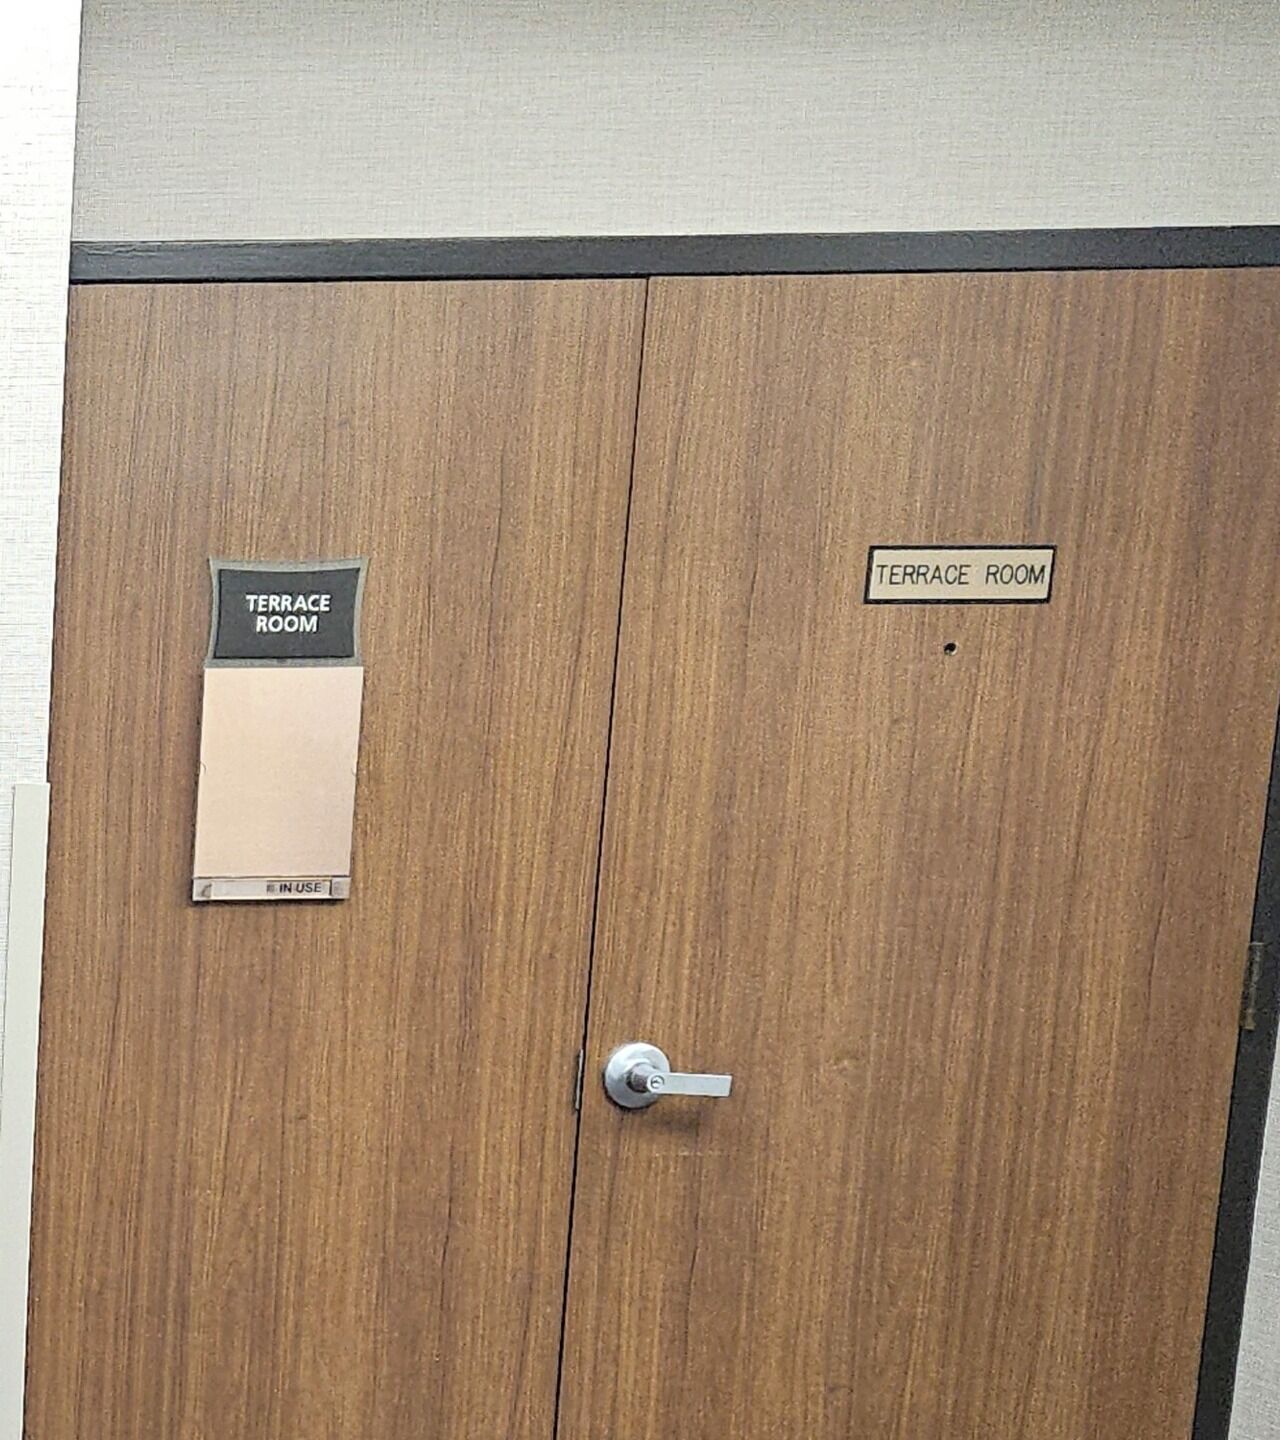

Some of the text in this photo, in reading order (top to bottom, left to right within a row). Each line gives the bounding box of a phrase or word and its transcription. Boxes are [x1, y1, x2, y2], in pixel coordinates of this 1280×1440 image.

[876, 563, 1047, 585] TERRACE ROOM
[245, 593, 332, 612] TERRACE
[256, 614, 319, 633] ROOM
[279, 882, 292, 893] IN
[295, 882, 322, 893] USE
